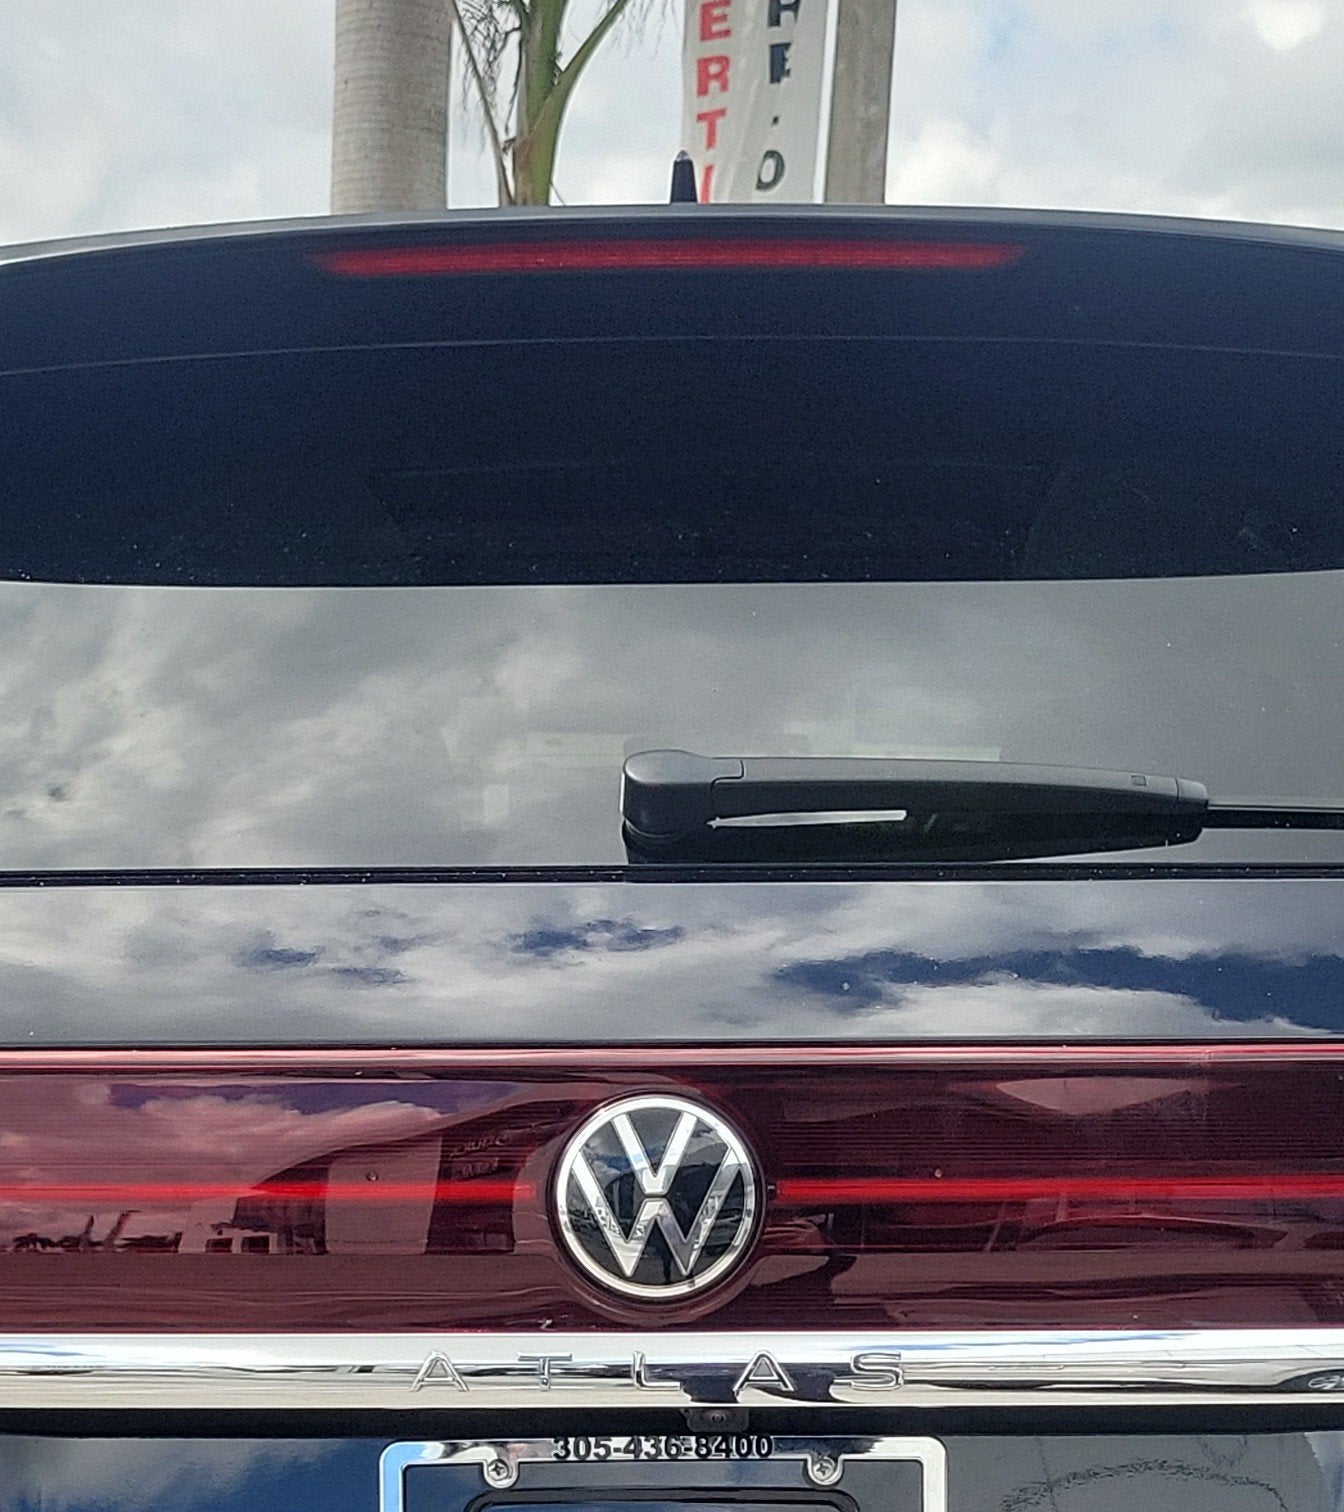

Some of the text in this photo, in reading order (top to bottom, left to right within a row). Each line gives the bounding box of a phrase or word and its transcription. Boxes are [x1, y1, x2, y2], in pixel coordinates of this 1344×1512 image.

[568, 1110, 746, 1278] VW
[409, 1349, 905, 1393] ATLAS
[552, 1436, 773, 1460] 305-436-8400
